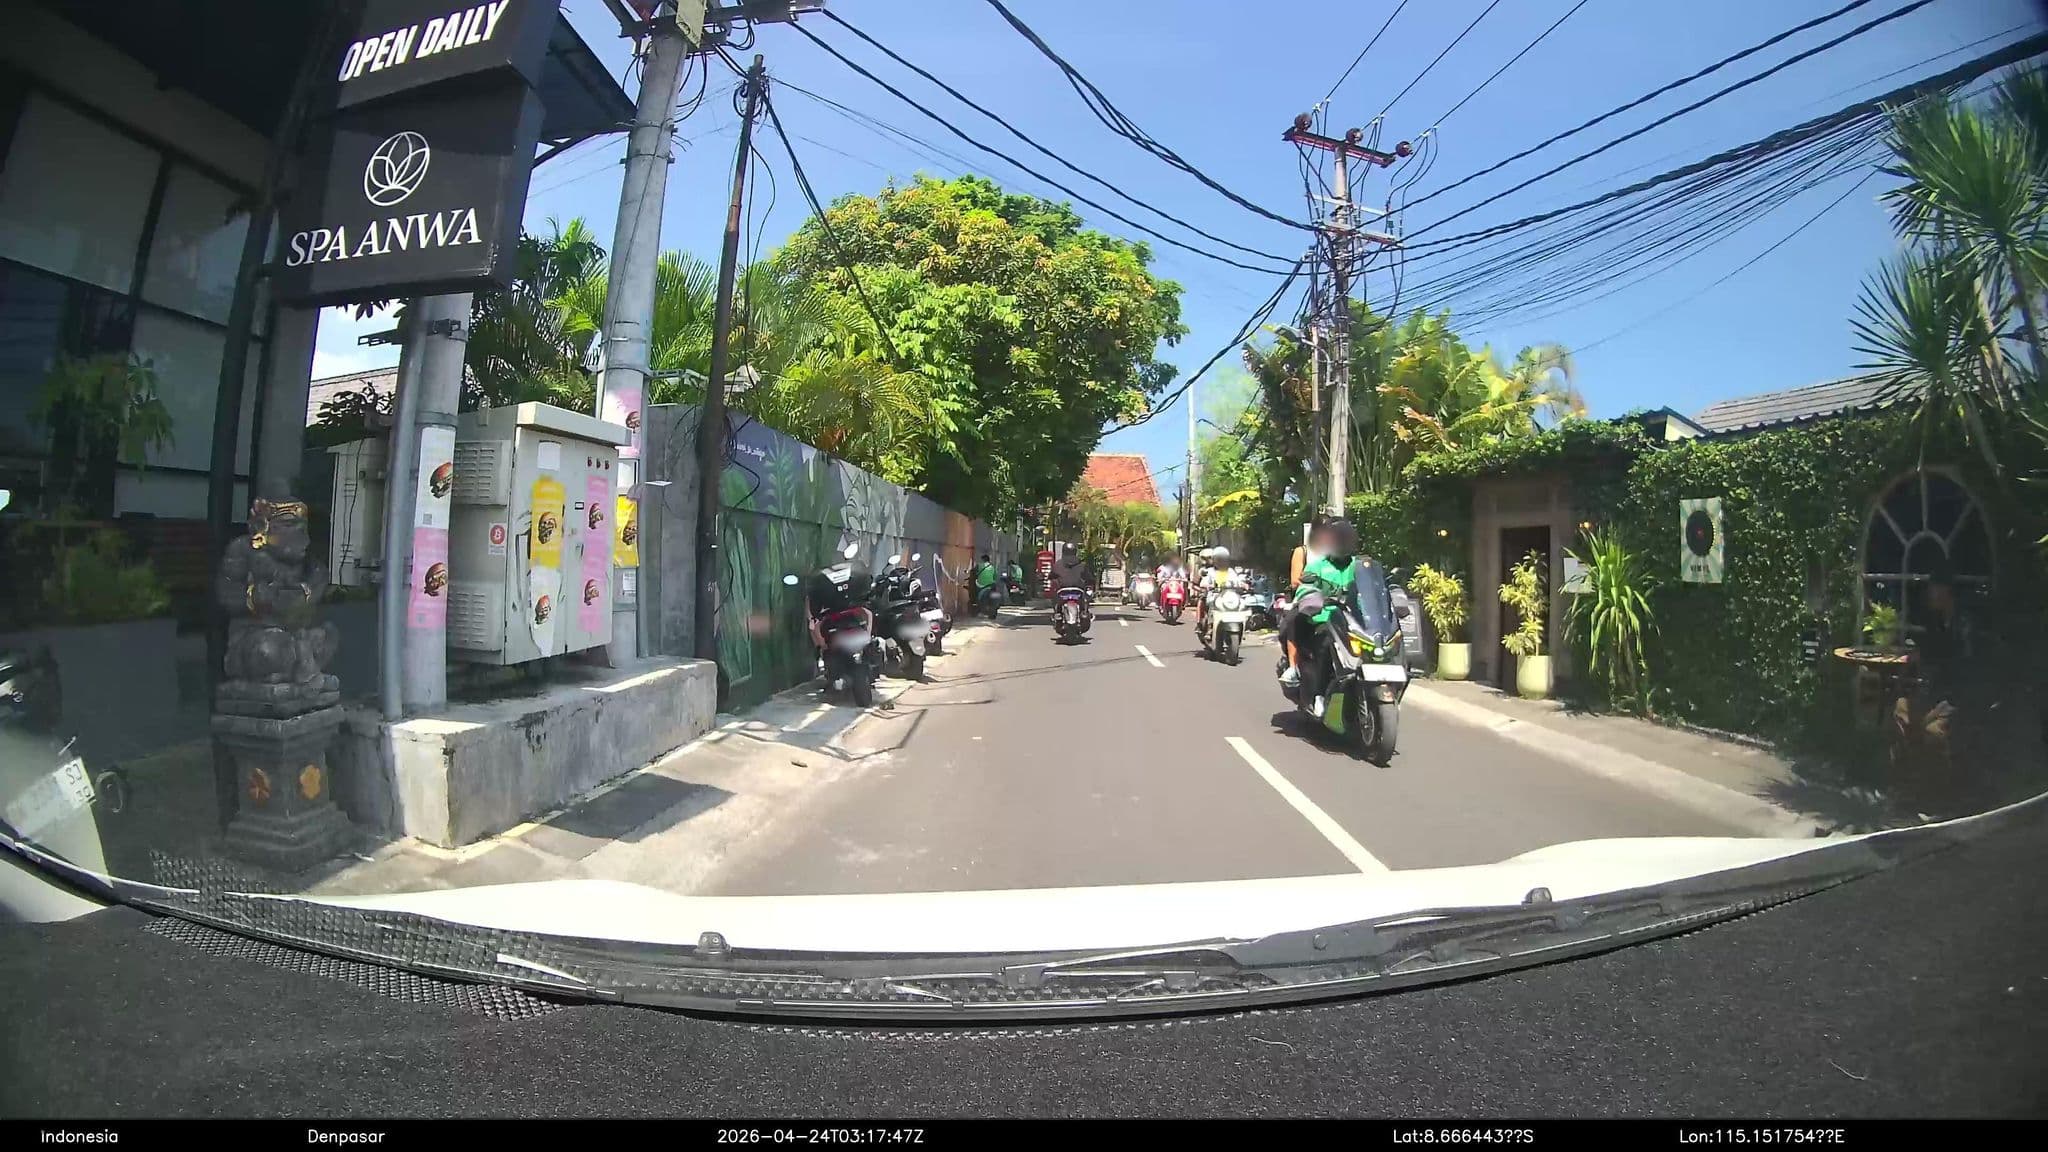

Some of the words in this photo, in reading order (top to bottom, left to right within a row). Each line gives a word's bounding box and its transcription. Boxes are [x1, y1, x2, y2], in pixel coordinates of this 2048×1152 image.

[338, 25, 418, 82] OPEN
[415, 0, 509, 59] DAILY
[286, 225, 349, 267] SPA
[351, 207, 483, 258] ANWA
